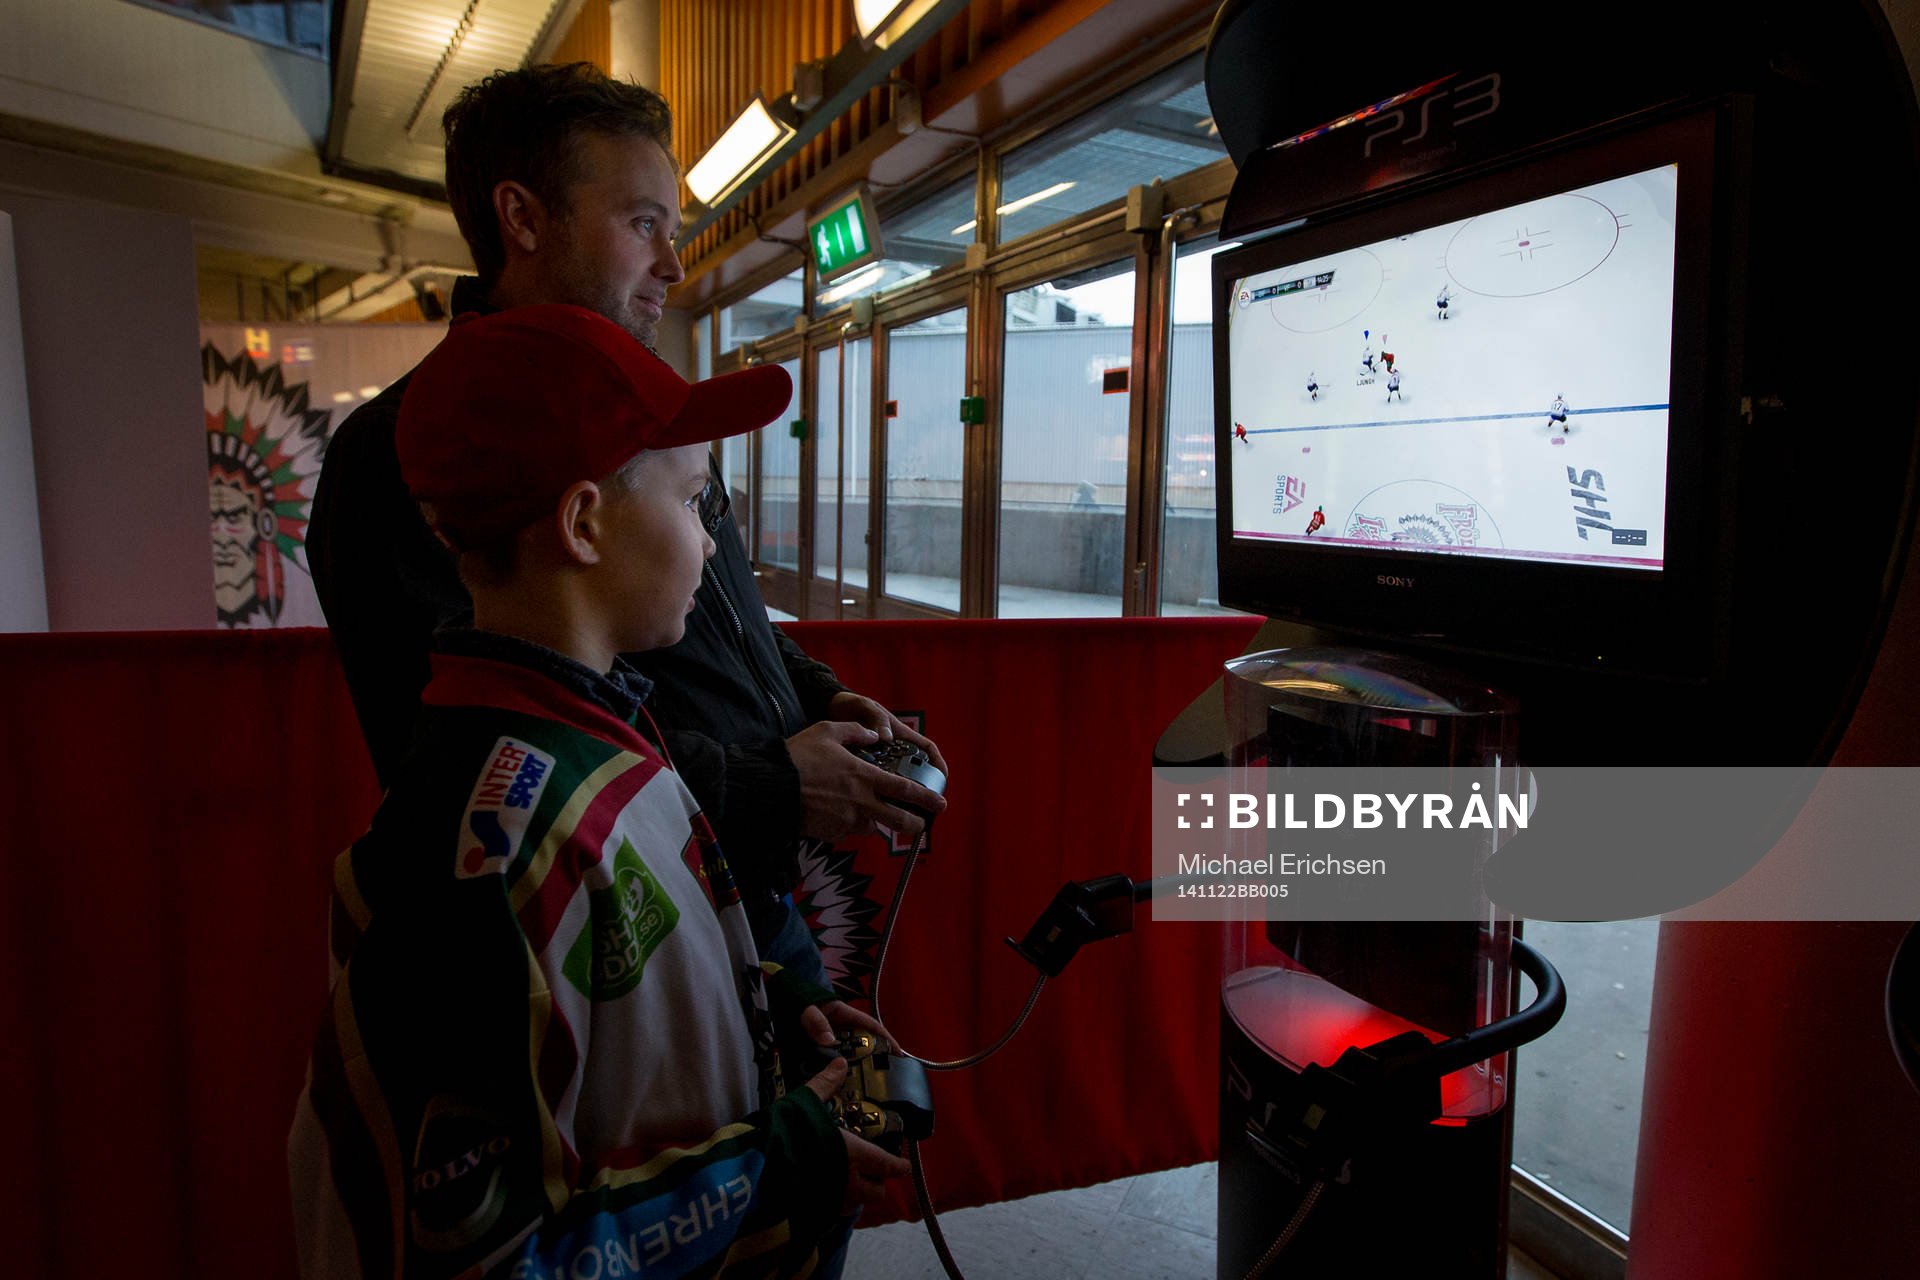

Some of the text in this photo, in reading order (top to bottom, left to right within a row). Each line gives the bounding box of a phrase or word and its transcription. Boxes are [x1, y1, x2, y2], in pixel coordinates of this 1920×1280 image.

[1363, 72, 1502, 159] PS3
[1272, 474, 1286, 514] SPORTS
[1567, 465, 1614, 541] SHL
[1376, 574, 1415, 588] SONY
[504, 753, 547, 809] SPORT
